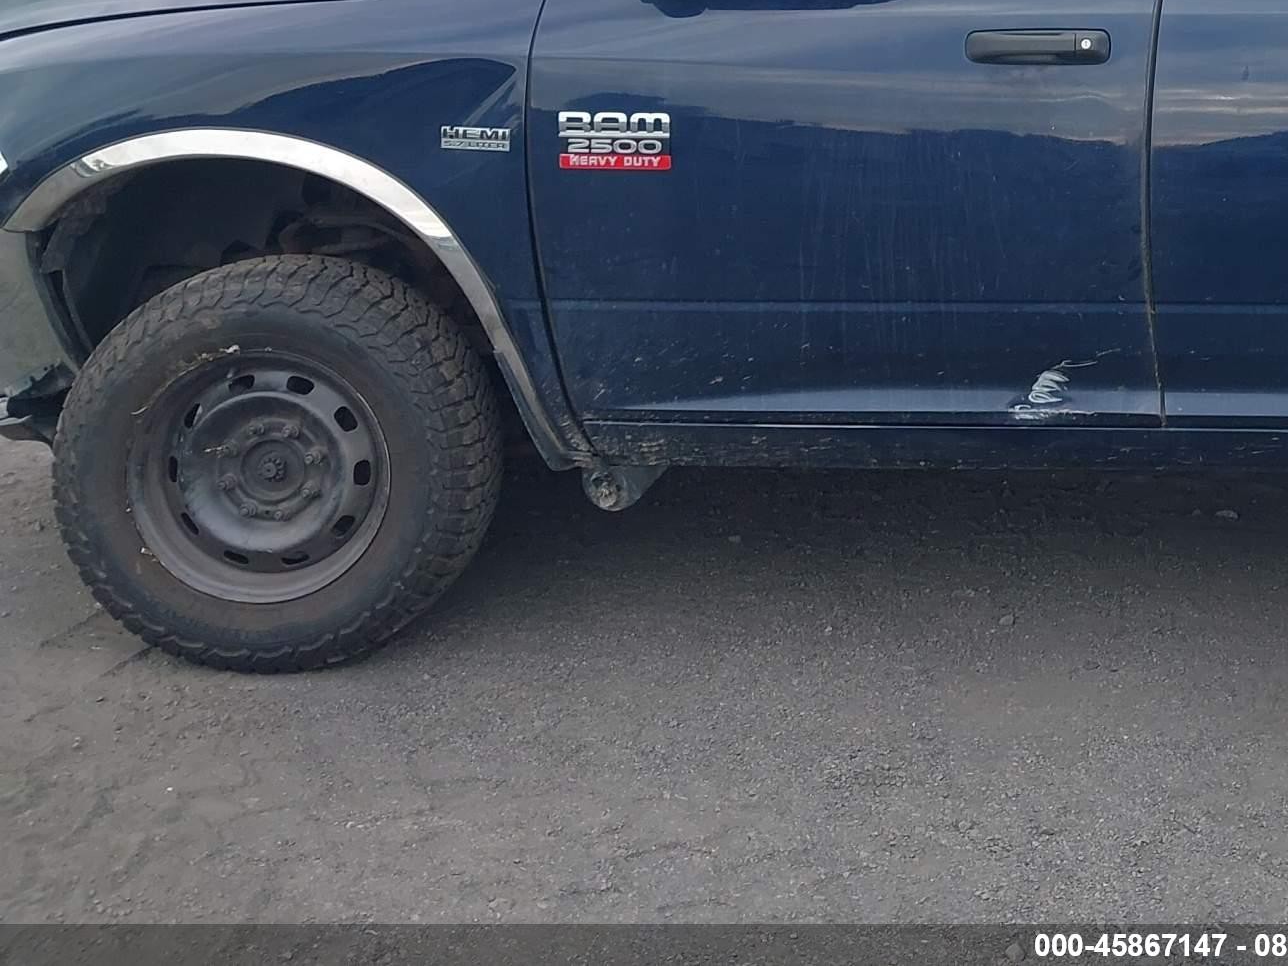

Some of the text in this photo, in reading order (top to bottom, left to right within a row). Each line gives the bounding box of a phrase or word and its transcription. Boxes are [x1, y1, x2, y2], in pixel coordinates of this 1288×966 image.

[558, 111, 671, 135] RAM
[442, 126, 510, 140] HEMI
[567, 138, 662, 154] 2500
[570, 154, 662, 166] HEAVY DUTY
